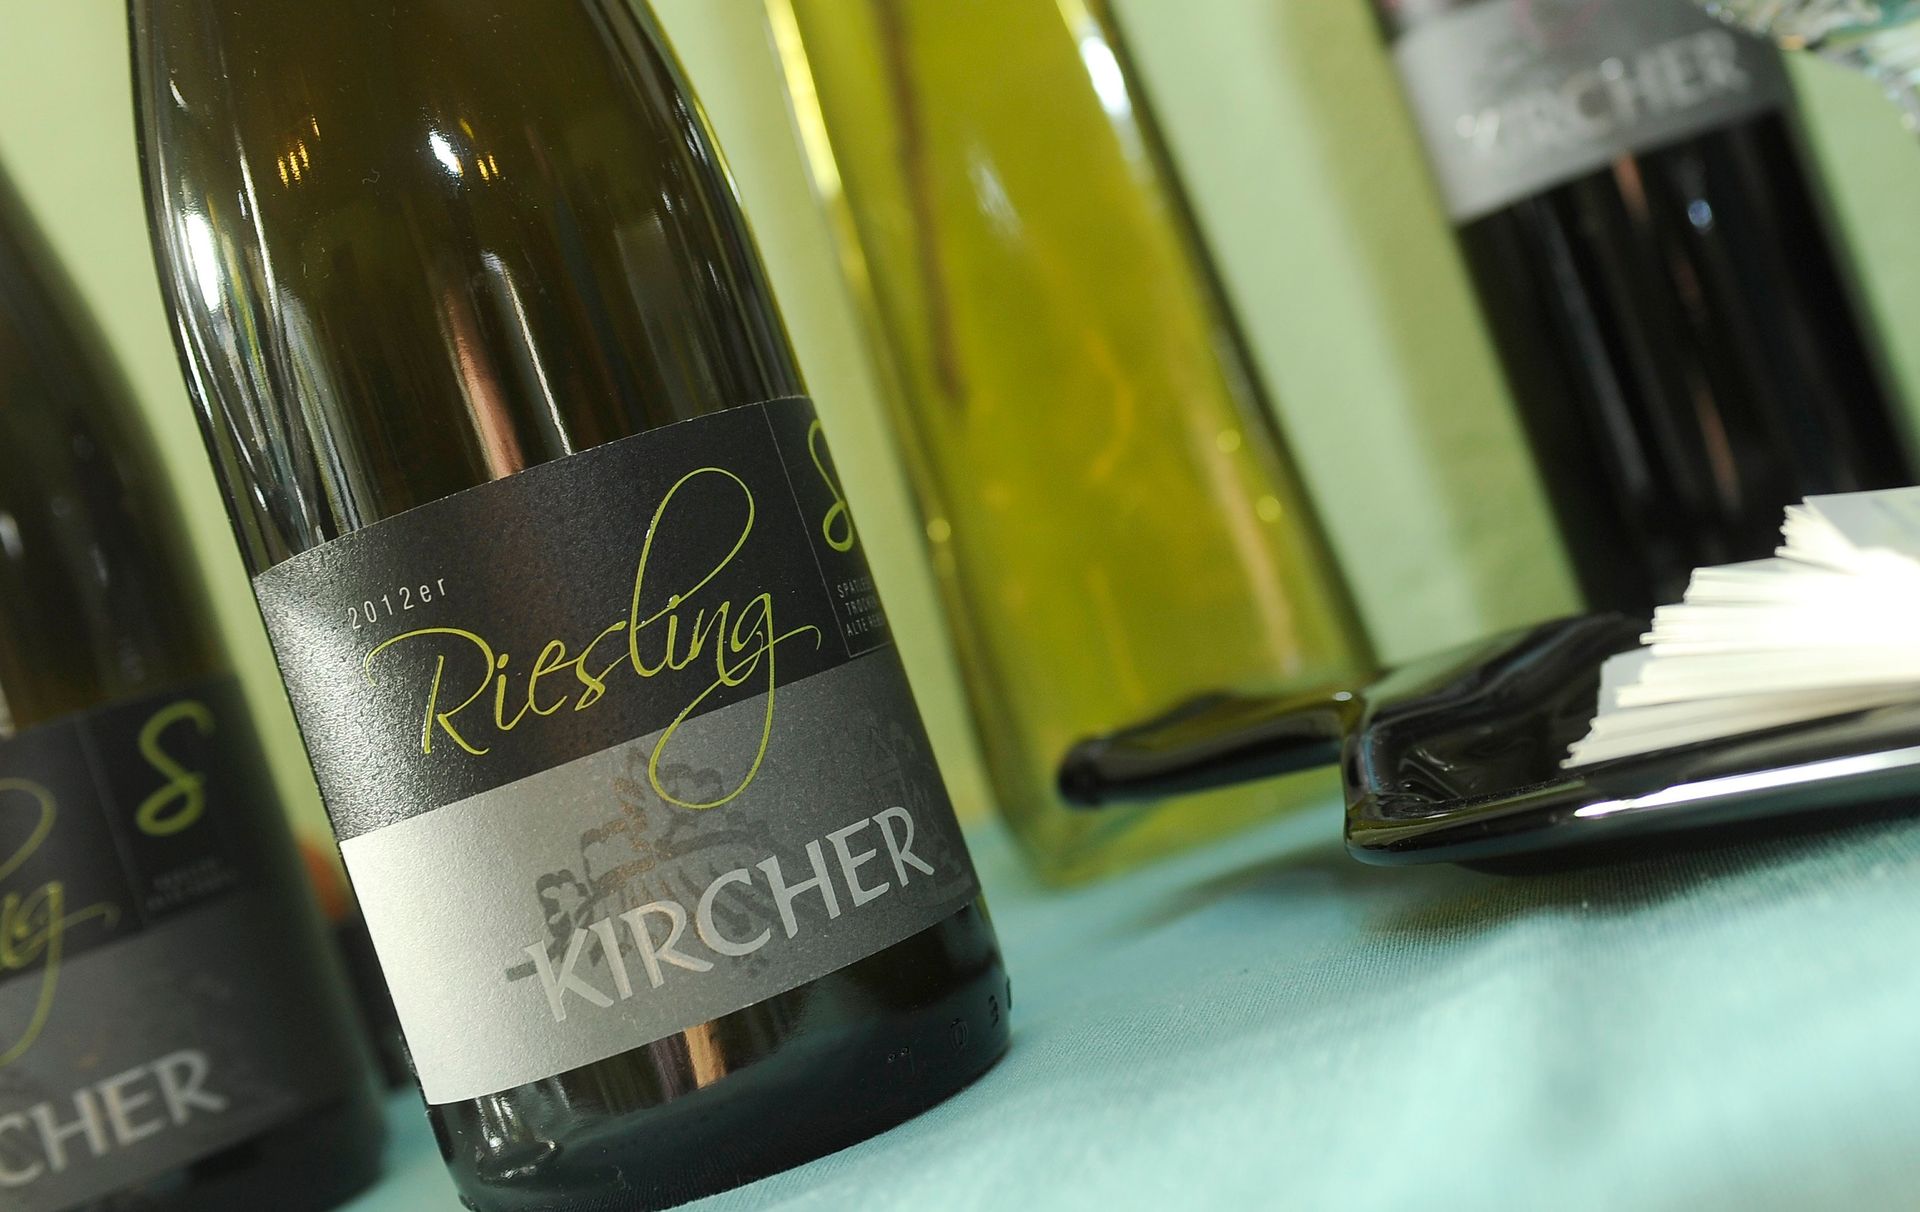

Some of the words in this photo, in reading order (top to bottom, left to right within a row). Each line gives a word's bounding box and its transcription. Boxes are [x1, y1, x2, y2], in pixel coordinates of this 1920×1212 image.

[347, 578, 446, 630] 2012er
[364, 467, 822, 809] Riesling
[523, 806, 935, 1022] KIRCHER
